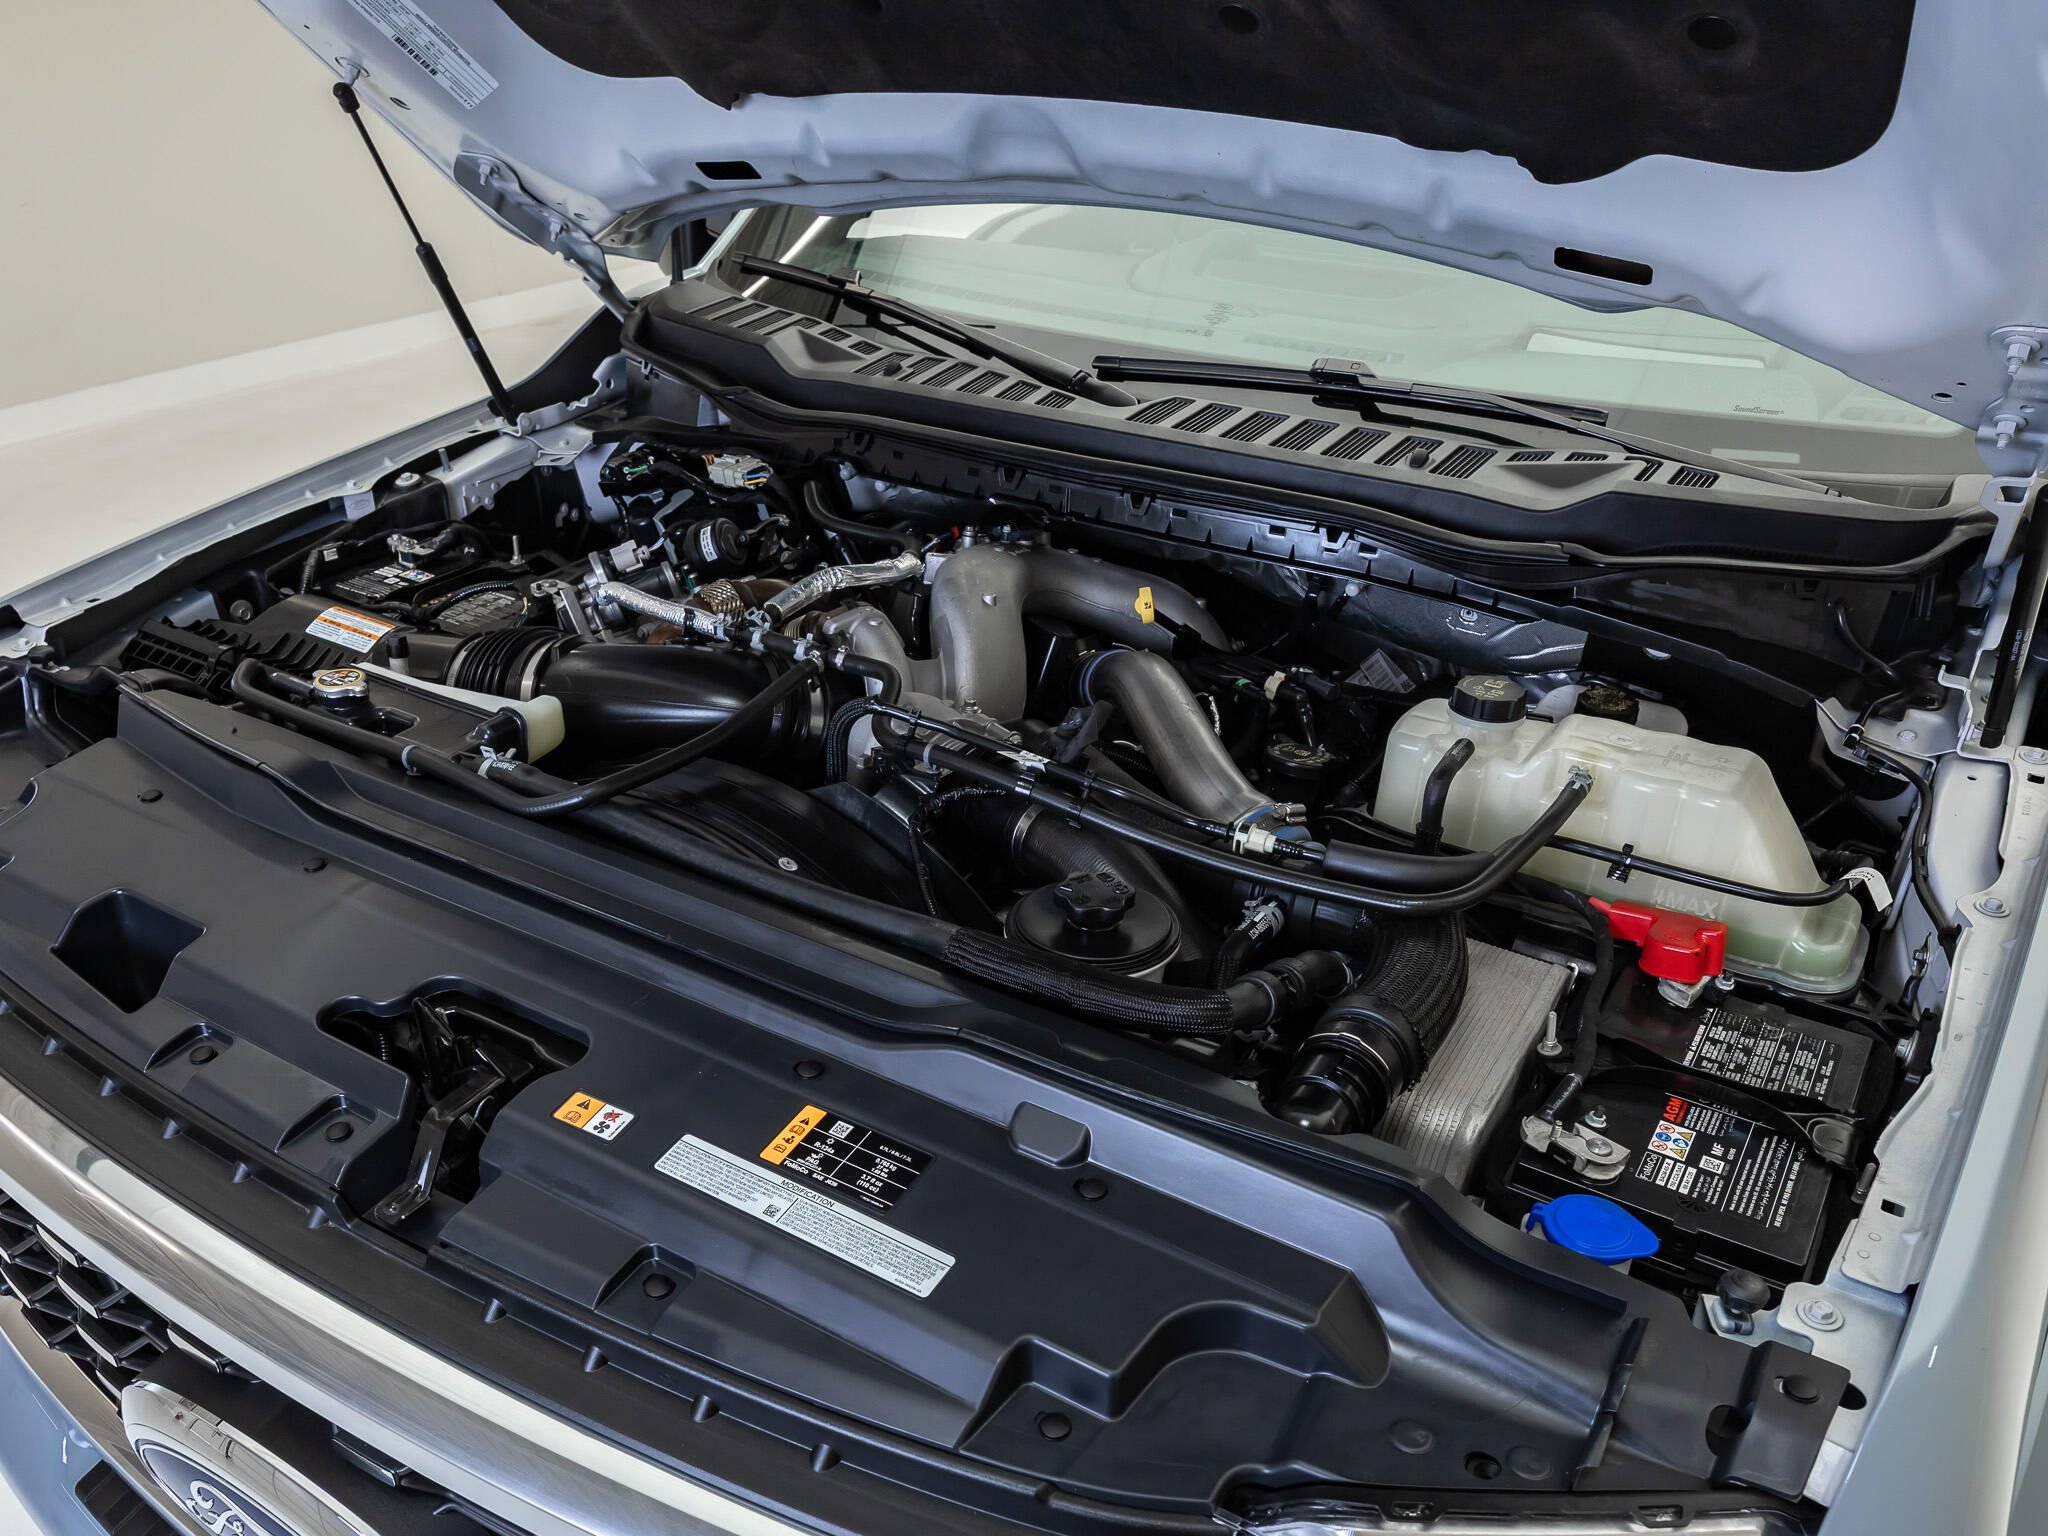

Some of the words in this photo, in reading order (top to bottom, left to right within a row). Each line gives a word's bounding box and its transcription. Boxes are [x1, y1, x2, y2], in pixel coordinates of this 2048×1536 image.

[1665, 891, 1718, 919] MAX
[1663, 1096, 1682, 1122] AGM
[814, 1142, 835, 1154] R-134a
[1711, 1142, 1725, 1157] MF
[805, 1156, 819, 1165] PAG
[889, 1164, 898, 1172] kg
[1640, 1153, 1658, 1181] FoMoCo
[783, 1160, 808, 1174] FoMoCo
[812, 1173, 824, 1182] SAE
[861, 1173, 870, 1182] 3.7
[856, 1179, 869, 1189] (110
[781, 1179, 835, 1208] MODIFICATION
